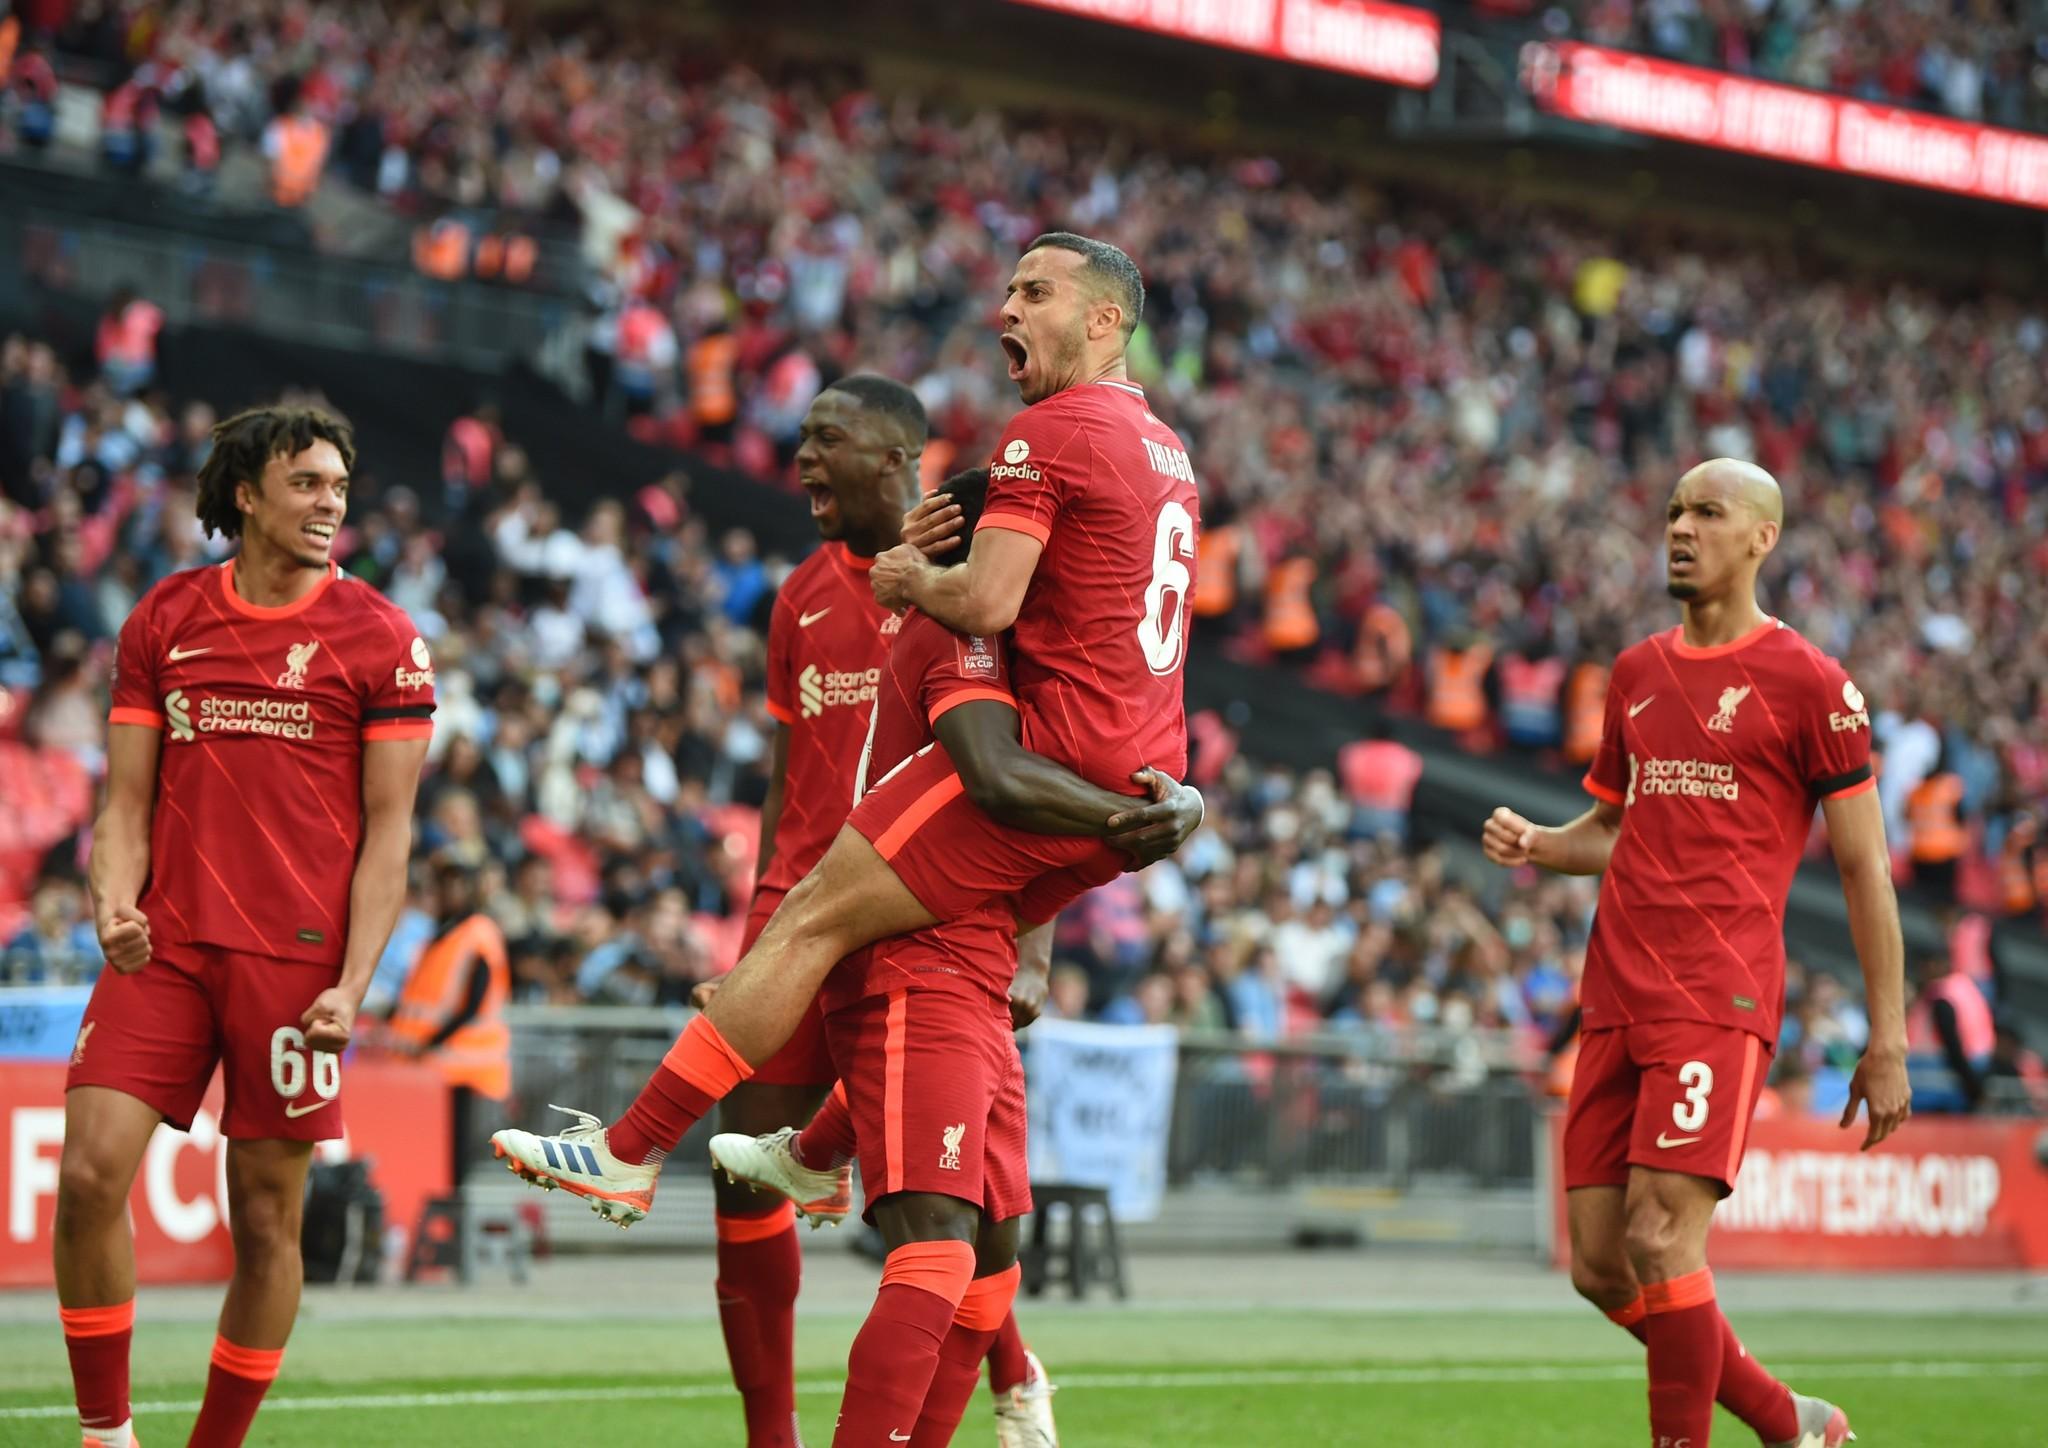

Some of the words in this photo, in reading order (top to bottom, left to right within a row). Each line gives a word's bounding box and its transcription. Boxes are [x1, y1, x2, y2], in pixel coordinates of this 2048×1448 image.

[991, 462, 1041, 481] Expedia
[1141, 437, 1195, 485] THIAGO
[1137, 501, 1194, 676] 6
[965, 662, 977, 670] FA
[977, 660, 994, 669] CUP
[200, 696, 309, 721] standard
[198, 715, 314, 740] chartered
[1643, 756, 1734, 782] standard
[1641, 776, 1739, 801] chartered
[271, 1025, 341, 1100] 66
[1671, 1060, 1714, 1133] 3
